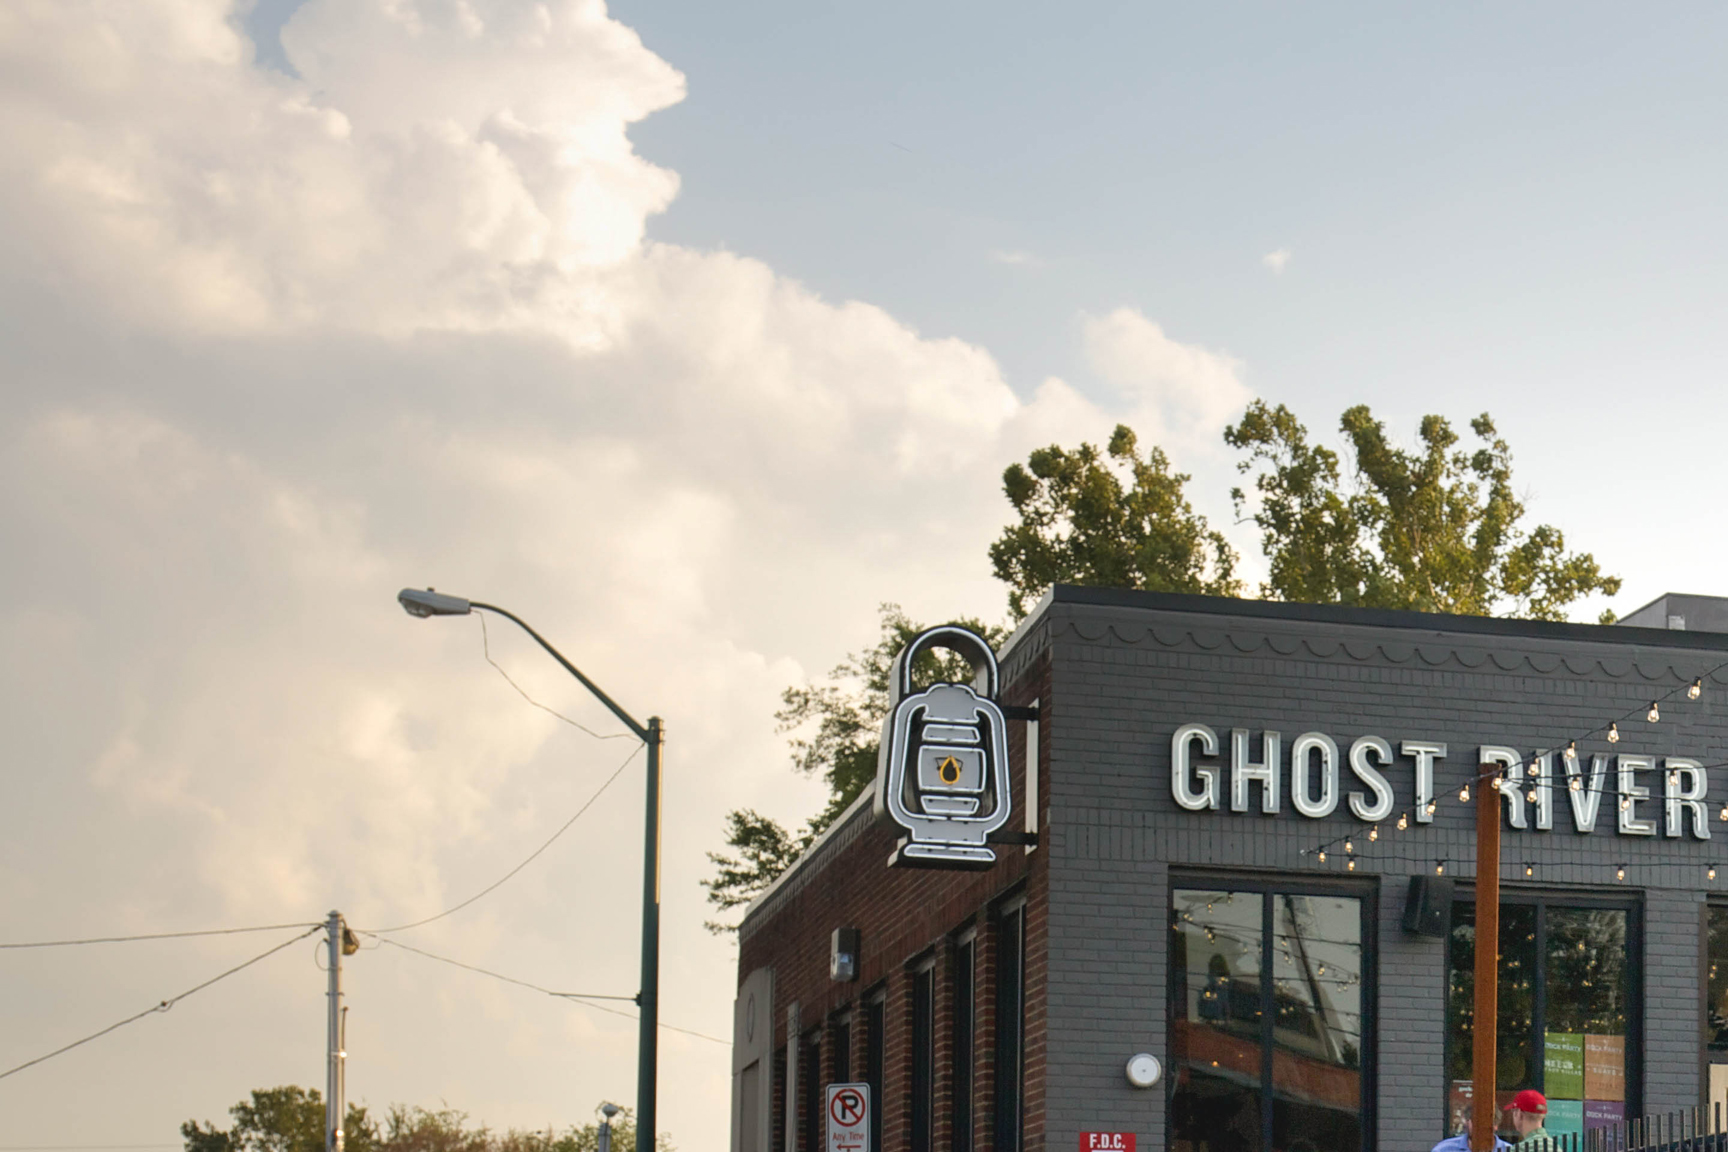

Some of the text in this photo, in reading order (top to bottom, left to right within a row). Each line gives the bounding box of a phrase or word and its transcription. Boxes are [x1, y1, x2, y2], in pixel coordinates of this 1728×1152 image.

[1171, 722, 1447, 824] GHOST
[1480, 744, 1710, 840] RIVER
[832, 1131, 865, 1143] Any Time
[1089, 1133, 1126, 1149] F.D.C.
